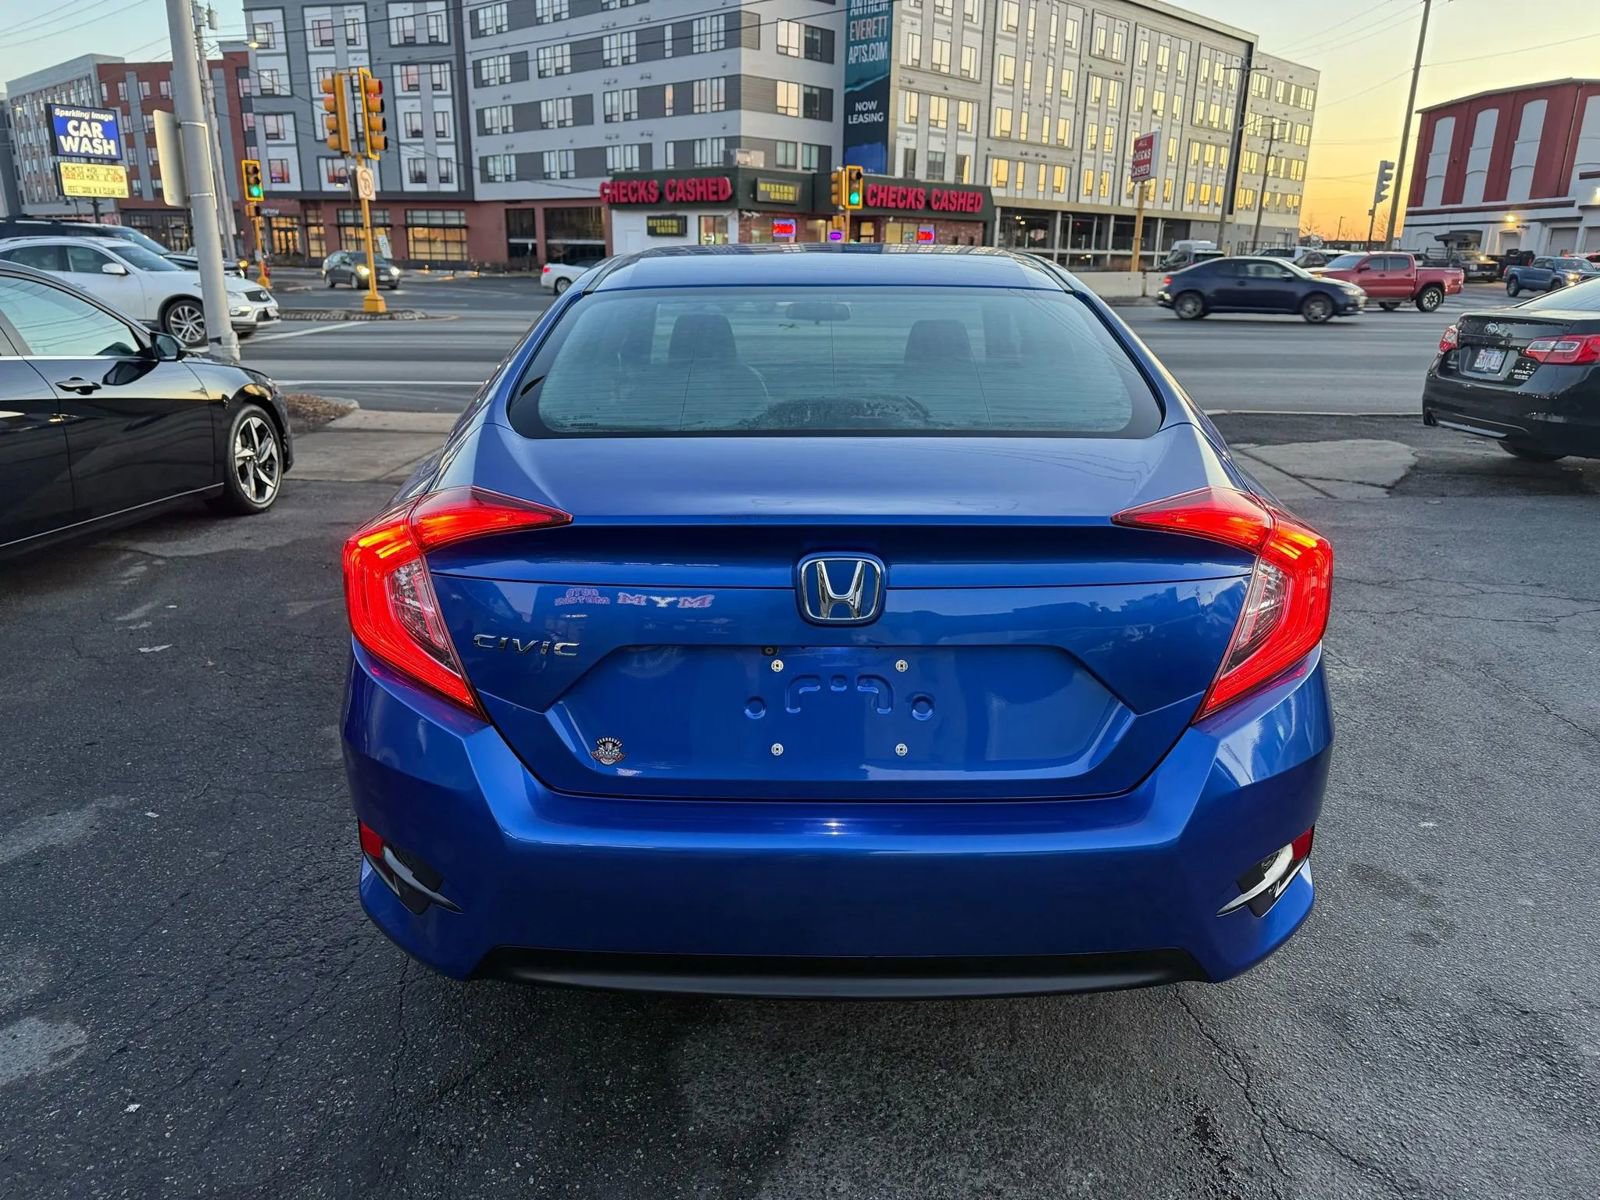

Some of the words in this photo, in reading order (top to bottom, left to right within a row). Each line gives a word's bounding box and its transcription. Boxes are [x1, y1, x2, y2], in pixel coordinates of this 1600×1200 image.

[849, 16, 889, 41] EVERETT
[848, 42, 888, 64] APTS.COM
[55, 108, 90, 120] Sparkling
[91, 112, 114, 122] Image
[855, 100, 878, 112] NOW
[848, 112, 884, 124] LEASING
[67, 120, 104, 138] CAR
[59, 135, 117, 155] WASH
[600, 180, 659, 203] CHECKS
[664, 176, 732, 202] CASHED
[759, 183, 795, 193] WESTERN
[770, 192, 794, 200] UNION
[866, 183, 926, 209] CHECKS
[931, 188, 983, 213] CASHED
[473, 633, 580, 656] CIVIC
